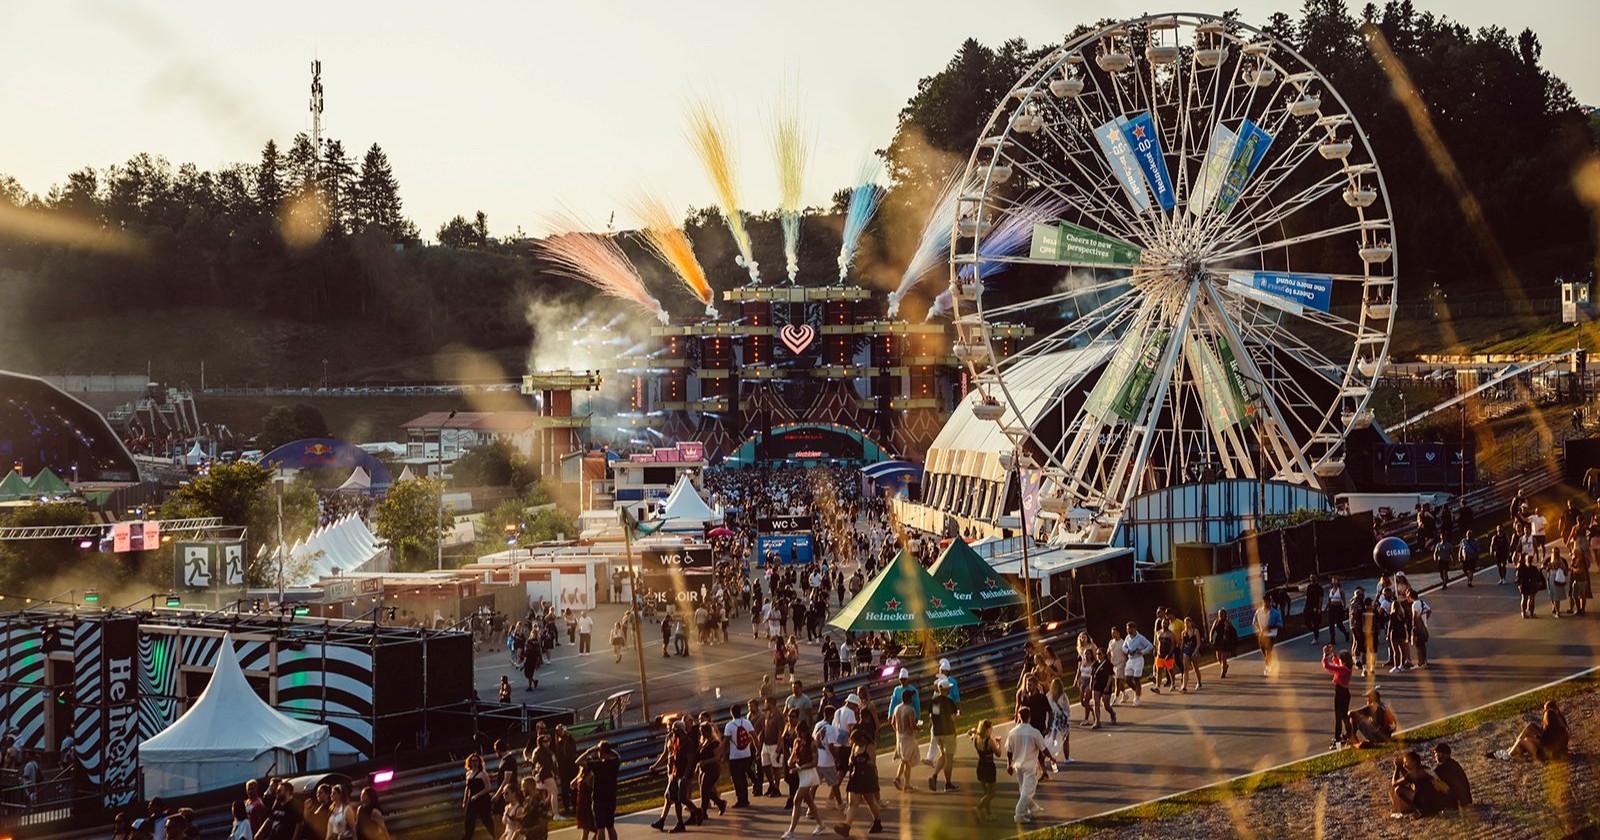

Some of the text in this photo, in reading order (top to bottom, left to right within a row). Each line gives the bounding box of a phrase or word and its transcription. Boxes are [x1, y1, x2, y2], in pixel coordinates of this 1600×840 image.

[1145, 151, 1167, 194] Heineken
[1066, 233, 1089, 245] Cheers
[1090, 238, 1097, 247] to
[1097, 241, 1112, 249] new
[1067, 243, 1109, 257] perspectives
[1275, 277, 1326, 292] one more round
[1285, 288, 1292, 296] to
[1293, 288, 1315, 300] Cheers
[771, 520, 789, 530] WC
[660, 554, 681, 565] WC
[652, 591, 698, 603] ISOIR
[980, 588, 1017, 600] Heineken
[865, 611, 915, 621] Heineken
[925, 607, 964, 619] Heineken
